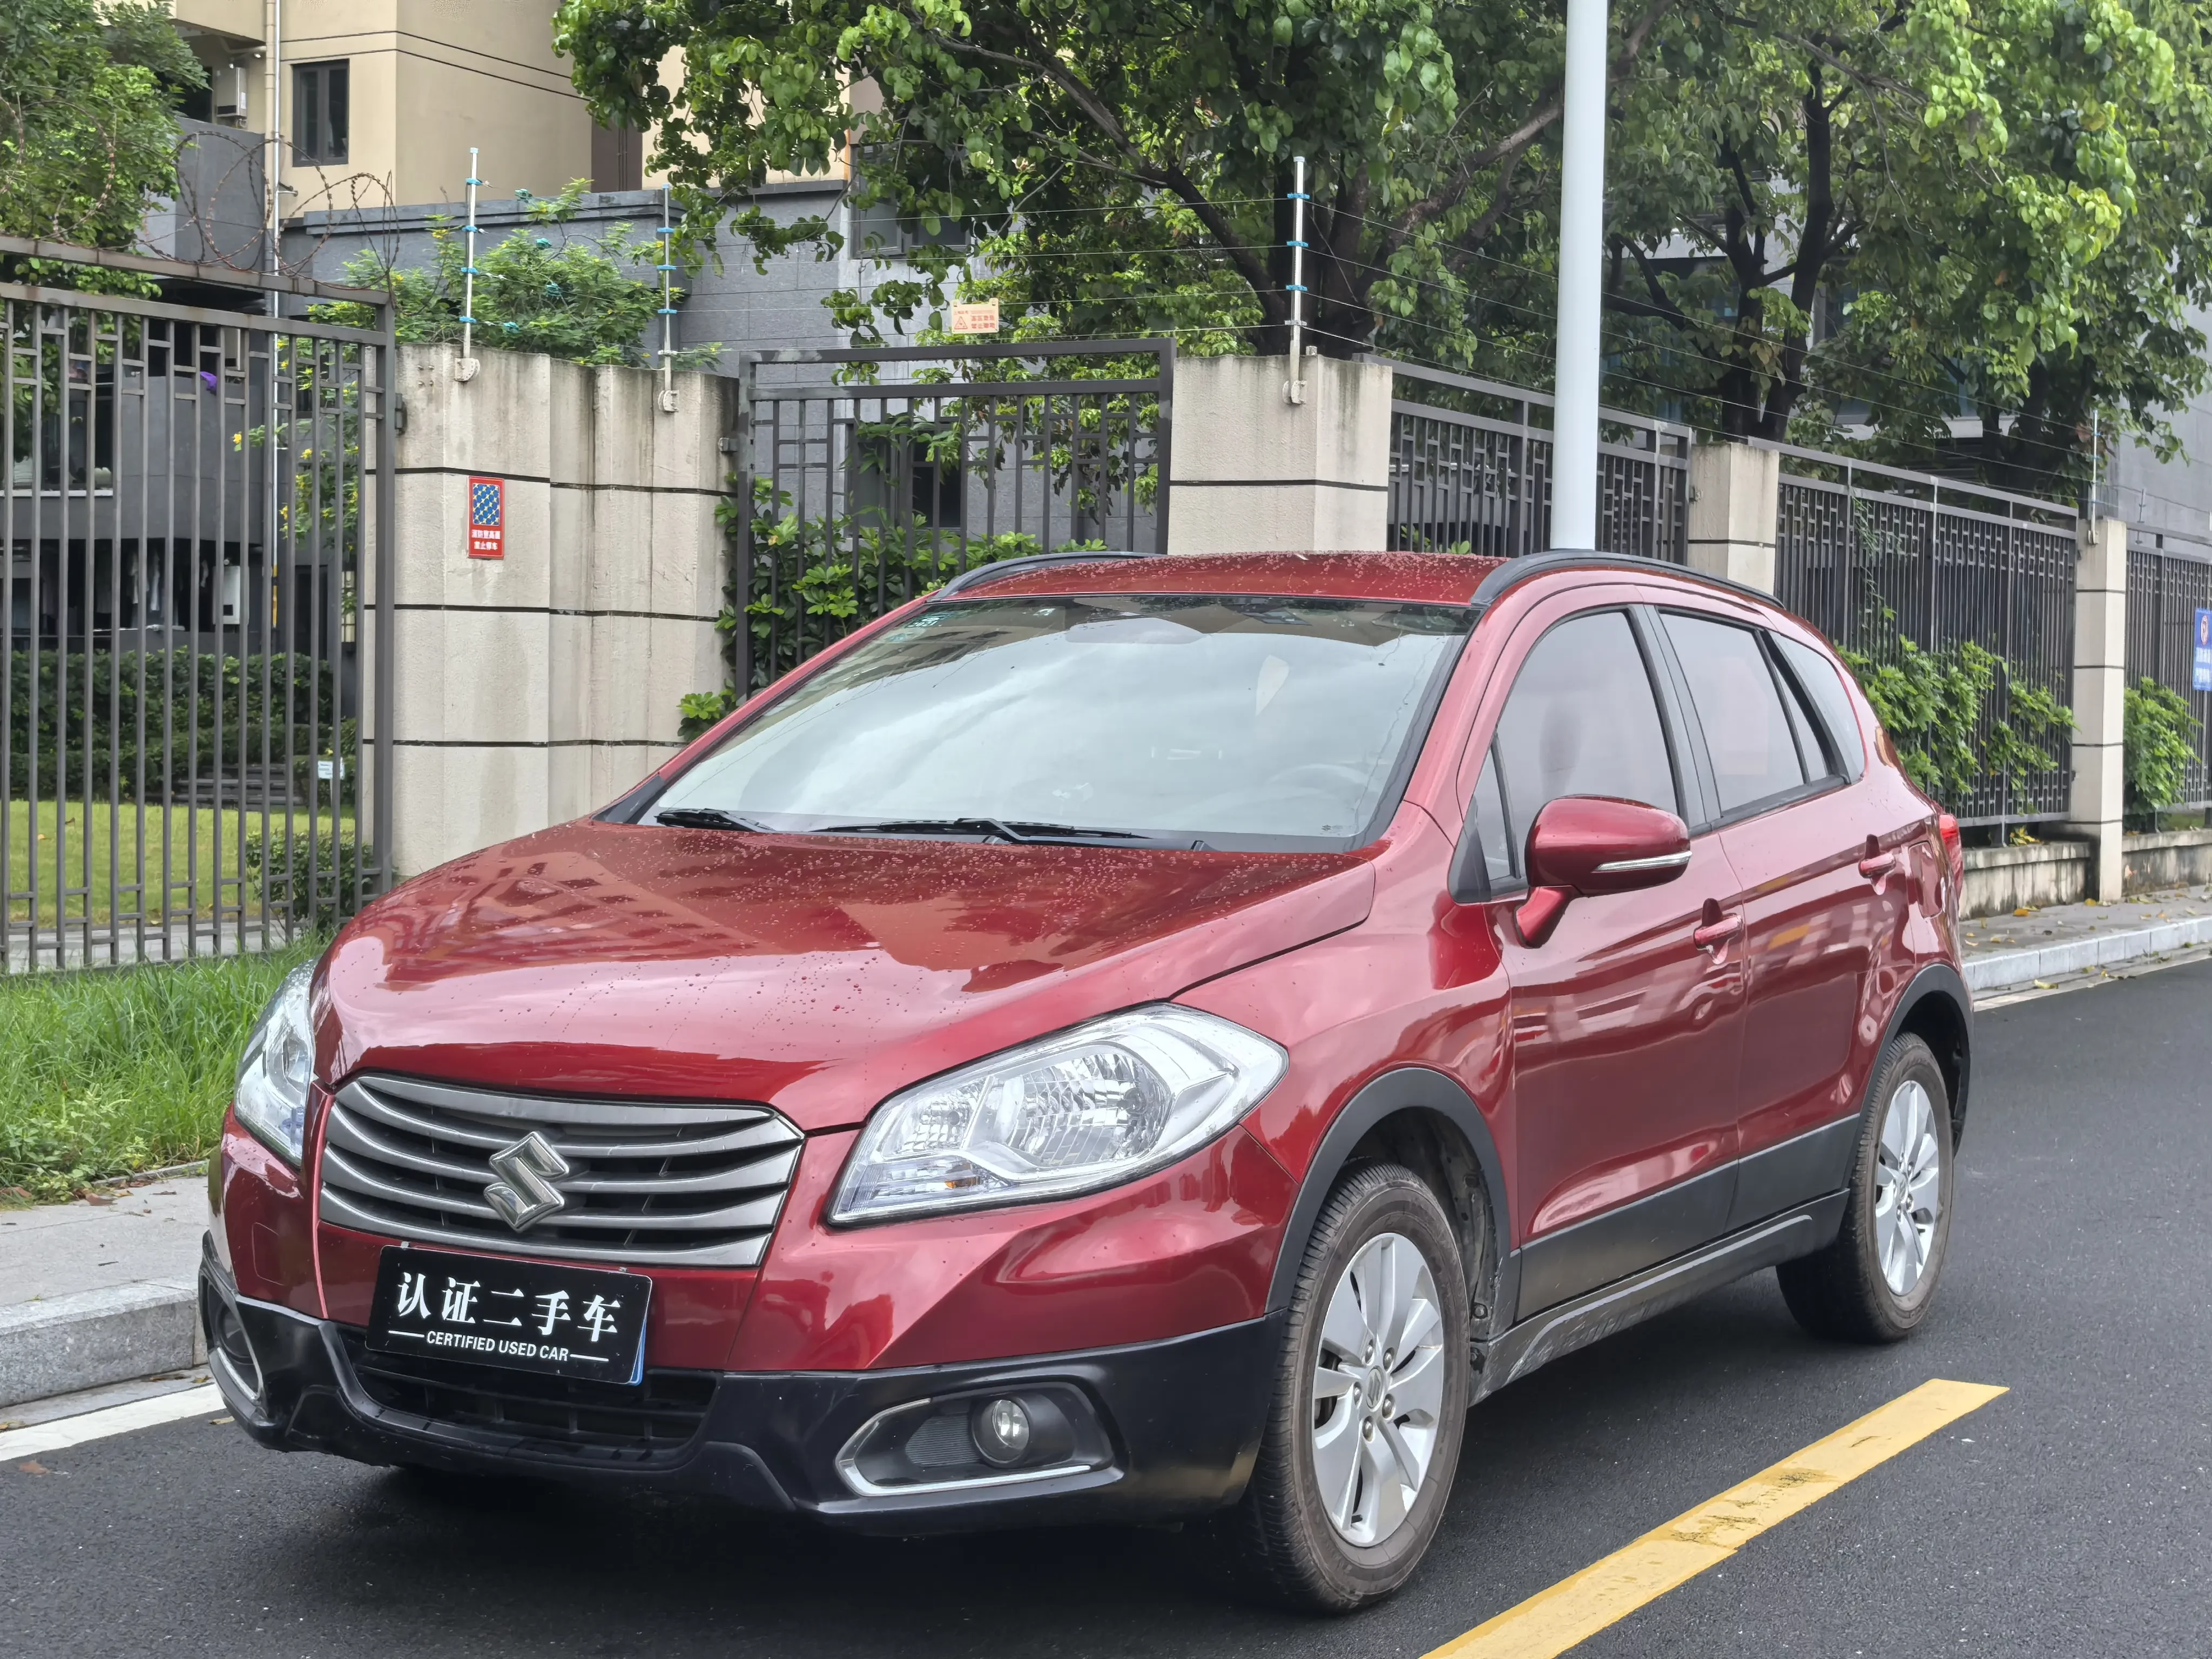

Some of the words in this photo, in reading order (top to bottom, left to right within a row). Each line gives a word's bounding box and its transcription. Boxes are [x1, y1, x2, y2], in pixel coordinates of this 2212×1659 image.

[396, 1272, 621, 1341] 认证二手车
[427, 1331, 495, 1351] CERTIFIED
[498, 1340, 536, 1357] USED
[539, 1345, 569, 1361] CAR
